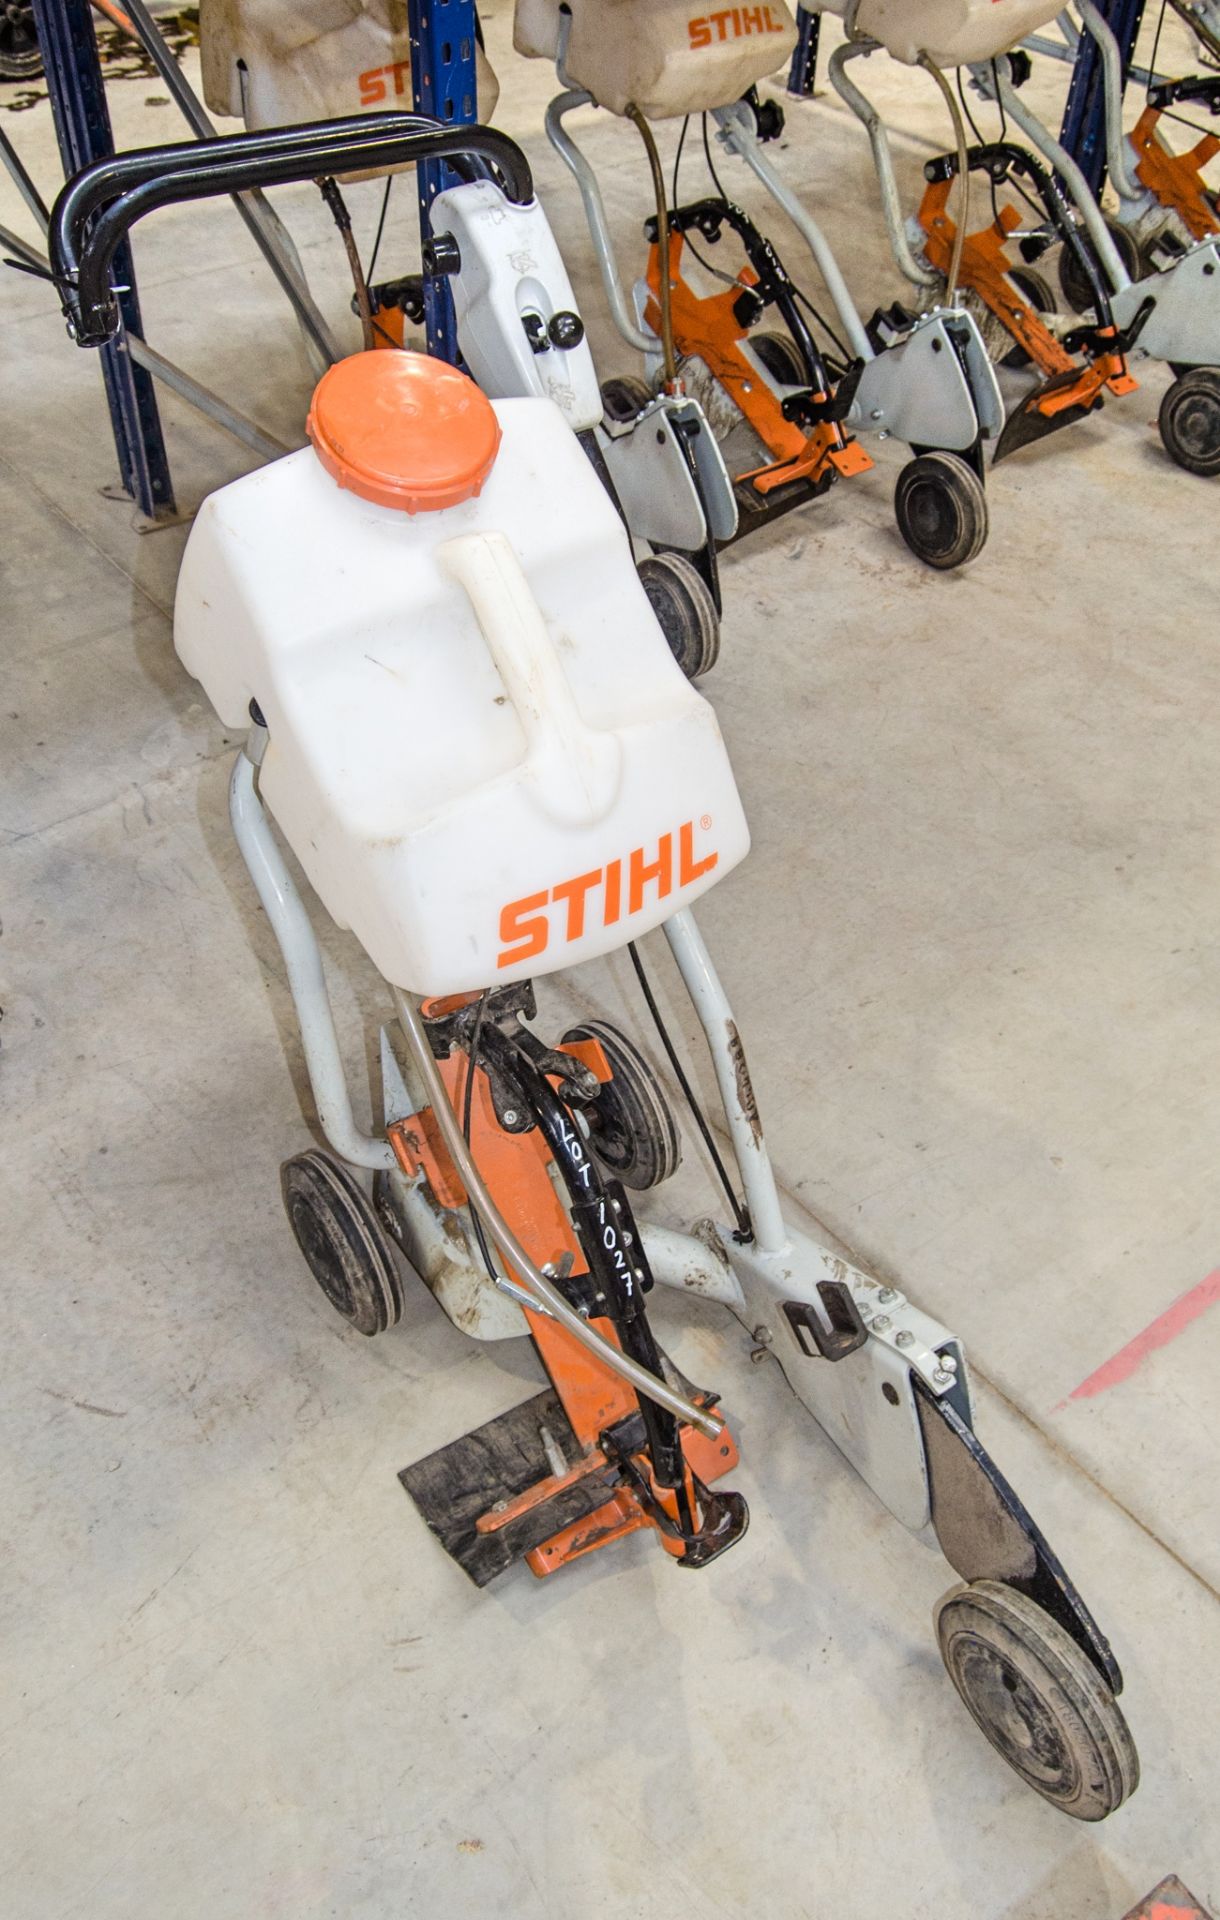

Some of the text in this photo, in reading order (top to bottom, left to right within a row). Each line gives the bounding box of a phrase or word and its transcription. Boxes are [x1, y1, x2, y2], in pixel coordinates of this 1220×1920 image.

[688, 6, 784, 51] STIHL
[559, 1118, 634, 1297] LOT 1027
